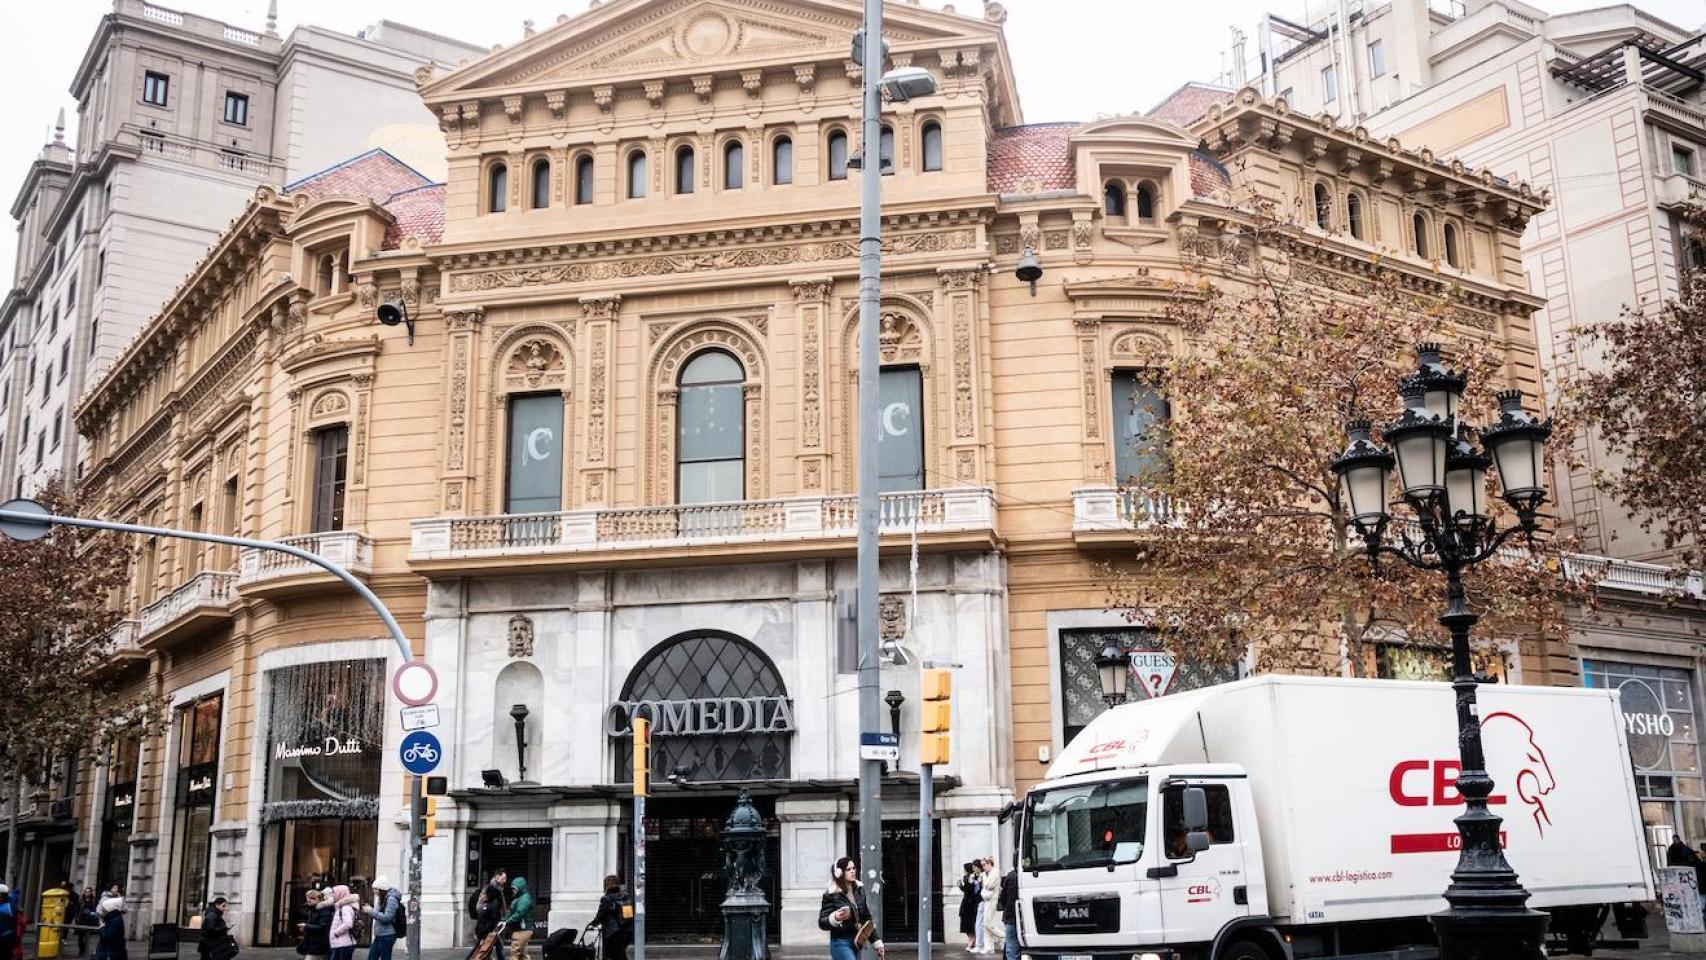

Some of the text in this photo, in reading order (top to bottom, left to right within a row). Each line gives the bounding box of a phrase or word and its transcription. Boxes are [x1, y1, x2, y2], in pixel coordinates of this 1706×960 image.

[1133, 655, 1176, 667] GUESS
[604, 695, 796, 737] COMEDIA
[1621, 712, 1674, 736] YSHO
[275, 736, 363, 760] Massimo Dutti
[1188, 885, 1212, 895] CBL
[1058, 907, 1089, 919] MAN
